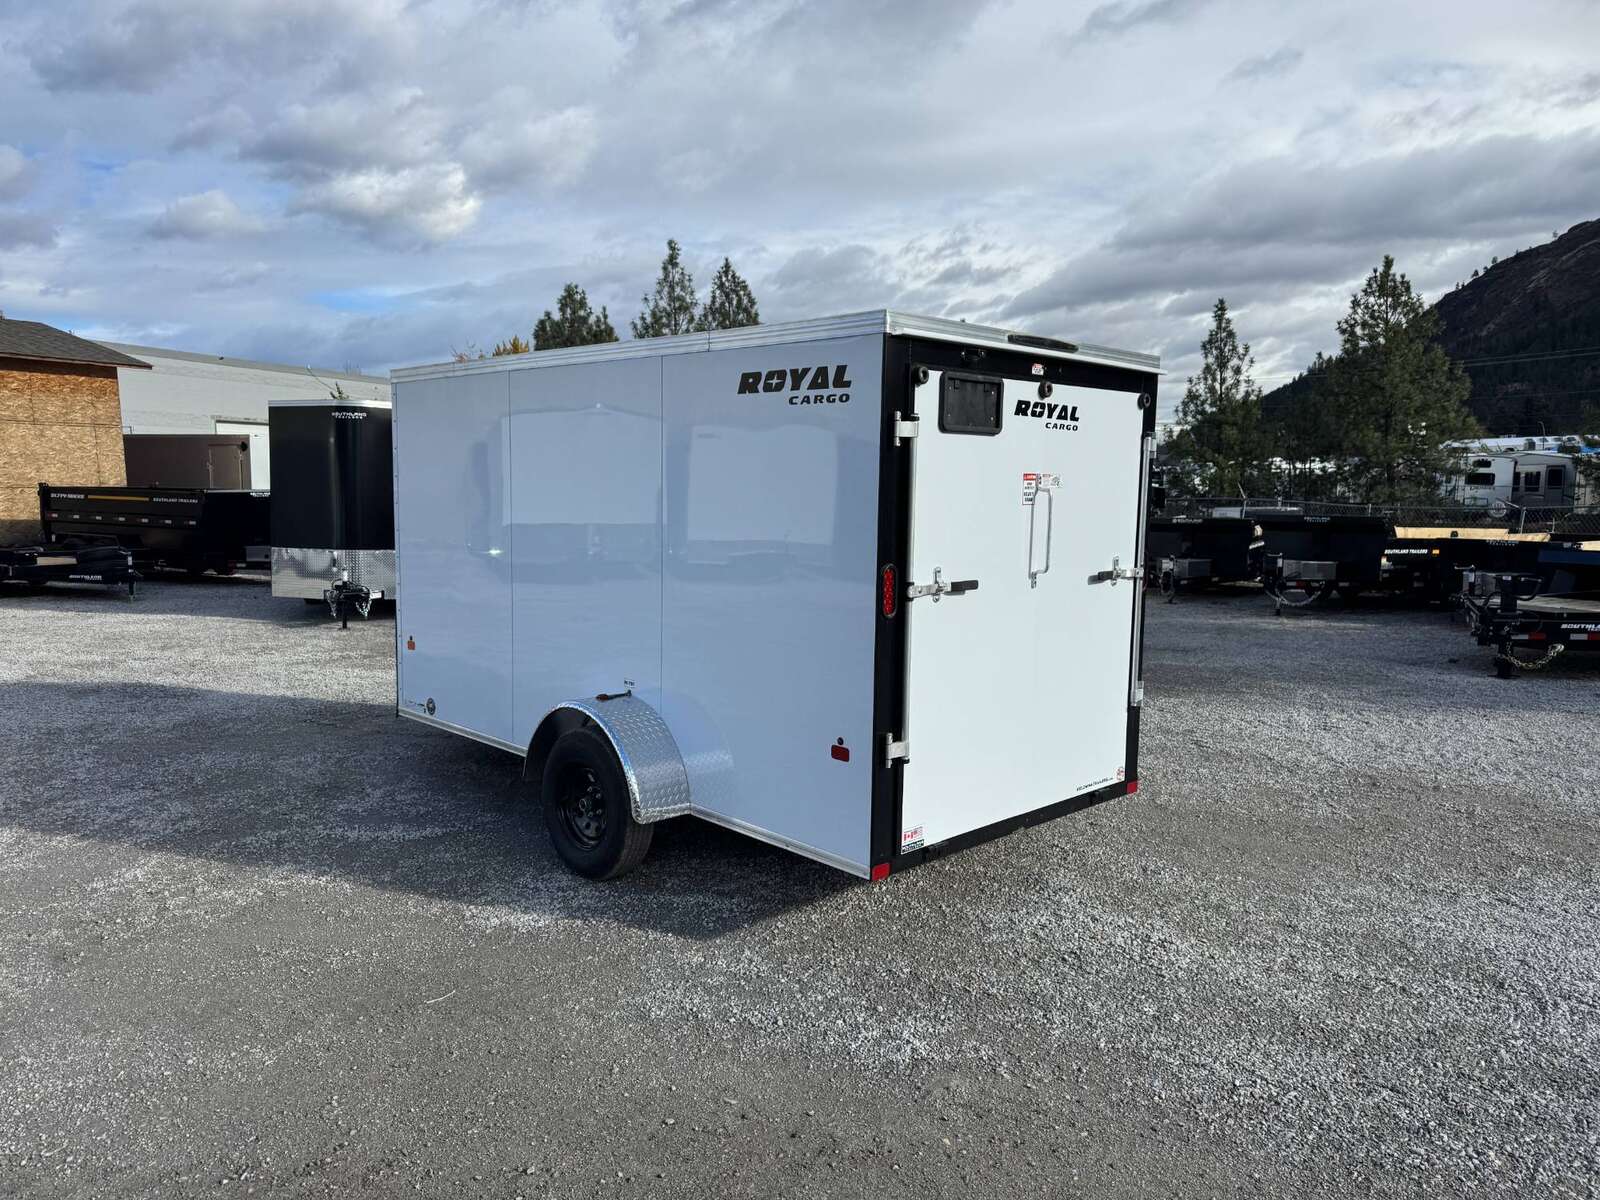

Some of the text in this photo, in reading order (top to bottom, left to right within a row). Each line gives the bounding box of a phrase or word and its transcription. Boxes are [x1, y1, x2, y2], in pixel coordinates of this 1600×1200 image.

[737, 364, 852, 394] ROYAL
[788, 393, 850, 405] CARGO
[1014, 399, 1080, 422] ROYAL
[1045, 422, 1078, 431] CARGO
